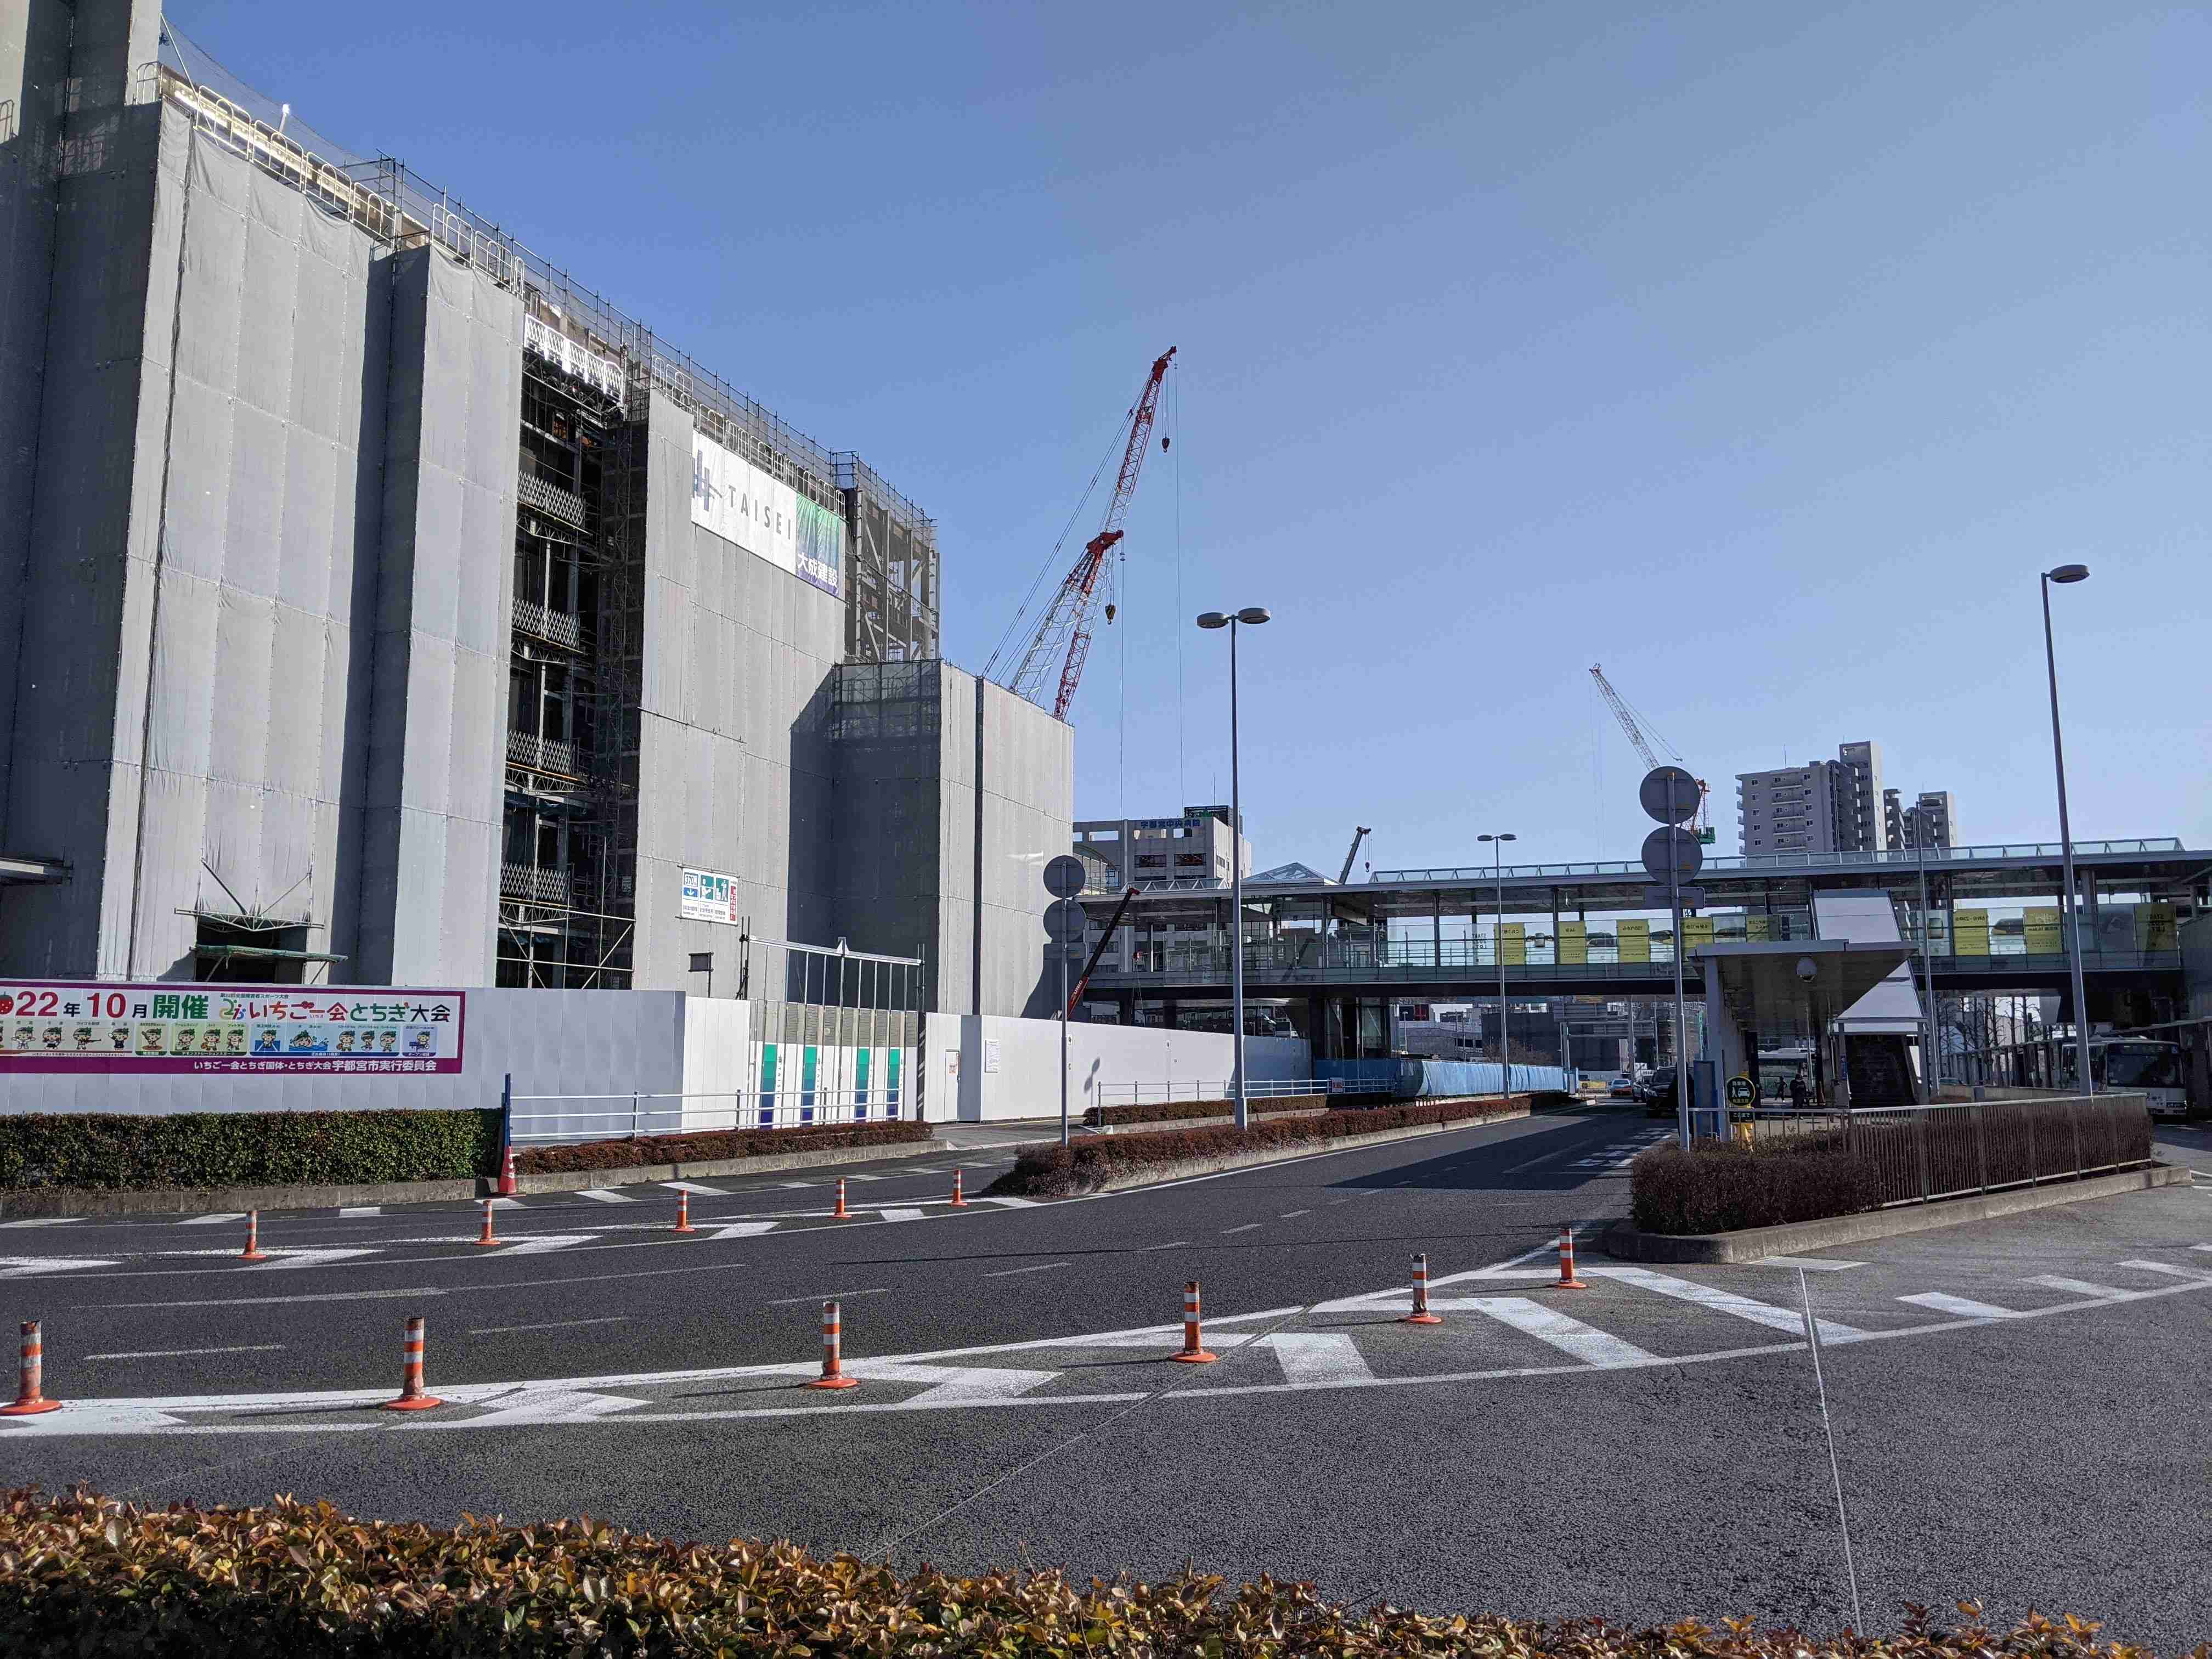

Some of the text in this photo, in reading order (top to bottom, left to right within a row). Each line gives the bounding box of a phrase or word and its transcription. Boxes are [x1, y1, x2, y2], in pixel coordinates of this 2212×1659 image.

[729, 484, 791, 540] TAISEI
[797, 552, 838, 588] 大成建設
